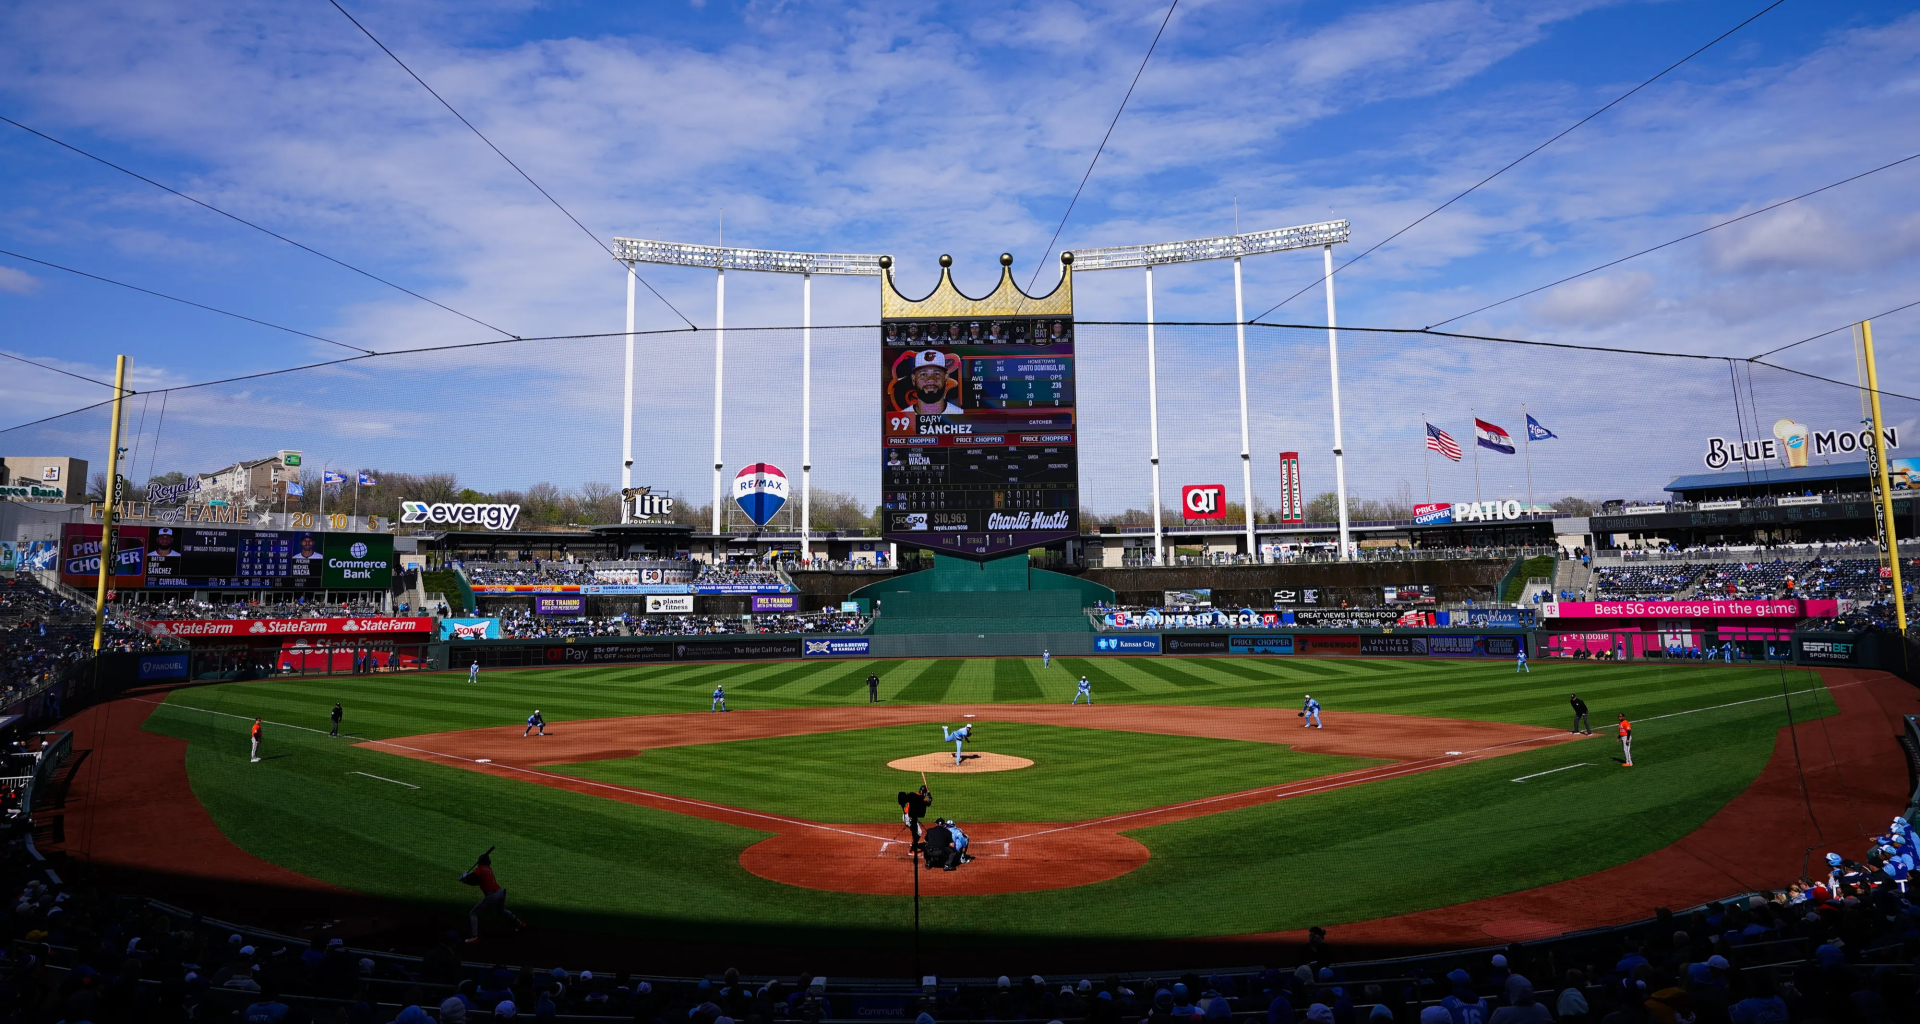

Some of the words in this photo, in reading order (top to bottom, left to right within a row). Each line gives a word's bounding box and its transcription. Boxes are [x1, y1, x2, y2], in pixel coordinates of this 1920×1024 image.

[1034, 329, 1047, 338] BAT
[1034, 364, 1058, 372] DOMINGO,
[891, 418, 910, 431] 99
[920, 416, 942, 424] GARY
[920, 421, 972, 434] SÁNCHEZ
[1706, 438, 1776, 468] BLUE
[1814, 428, 1898, 454] MOON
[908, 457, 930, 465] WACHA
[1870, 447, 1878, 478] ROOT
[1874, 486, 1881, 495] 4
[114, 474, 122, 505] ROOT
[740, 479, 782, 491] RE/MAX
[1292, 463, 1300, 514] BOULEVARD
[31, 486, 63, 497] Bank
[147, 478, 201, 504] Royals
[625, 486, 651, 500] Miller
[634, 494, 674, 519] Lite
[898, 502, 907, 510] KC
[1186, 488, 1218, 514] QT
[90, 500, 156, 522] HALL
[162, 506, 184, 524] of
[184, 504, 250, 524] FAME
[1416, 504, 1437, 516] PRICE
[1455, 500, 1522, 522] PATIO
[1808, 508, 1820, 517] -15
[292, 512, 314, 528] 20
[330, 514, 348, 529] 10
[367, 515, 378, 530] 5
[432, 506, 518, 528] evergy
[934, 513, 966, 524] $10,963
[988, 511, 1030, 530] Charlie
[1031, 510, 1069, 530] Hustle
[1416, 510, 1451, 524] CHOPPER
[1707, 514, 1717, 523] 75
[1756, 511, 1768, 521] -10
[1606, 518, 1648, 529] CURVEBALL
[329, 558, 387, 569] Commerce
[148, 566, 172, 575] SÁNCHEZ
[344, 569, 371, 579] Bank
[1304, 590, 1318, 599] KC
[663, 598, 684, 606] planet
[1547, 605, 1555, 614] T
[1595, 604, 1623, 614] Best
[1626, 604, 1644, 614] 5G
[1648, 603, 1709, 616] coverage
[1713, 603, 1725, 614] in
[1729, 602, 1752, 614] the
[1756, 604, 1796, 616] game
[1133, 615, 1211, 625] FOUNTAIN
[1218, 615, 1260, 625] DECK
[457, 627, 485, 635] SONIC
[1666, 622, 1682, 640] T
[1430, 638, 1458, 647] POWDER
[1803, 642, 1832, 652] ESPN
[1833, 644, 1853, 653] BET
[547, 648, 563, 660] QT
[566, 648, 588, 662] Pay
[746, 646, 760, 654] Right
[1810, 652, 1849, 660] SPORTSBOOK
[152, 662, 183, 671] FANDUEL
[1462, 1008, 1482, 1024] 16
